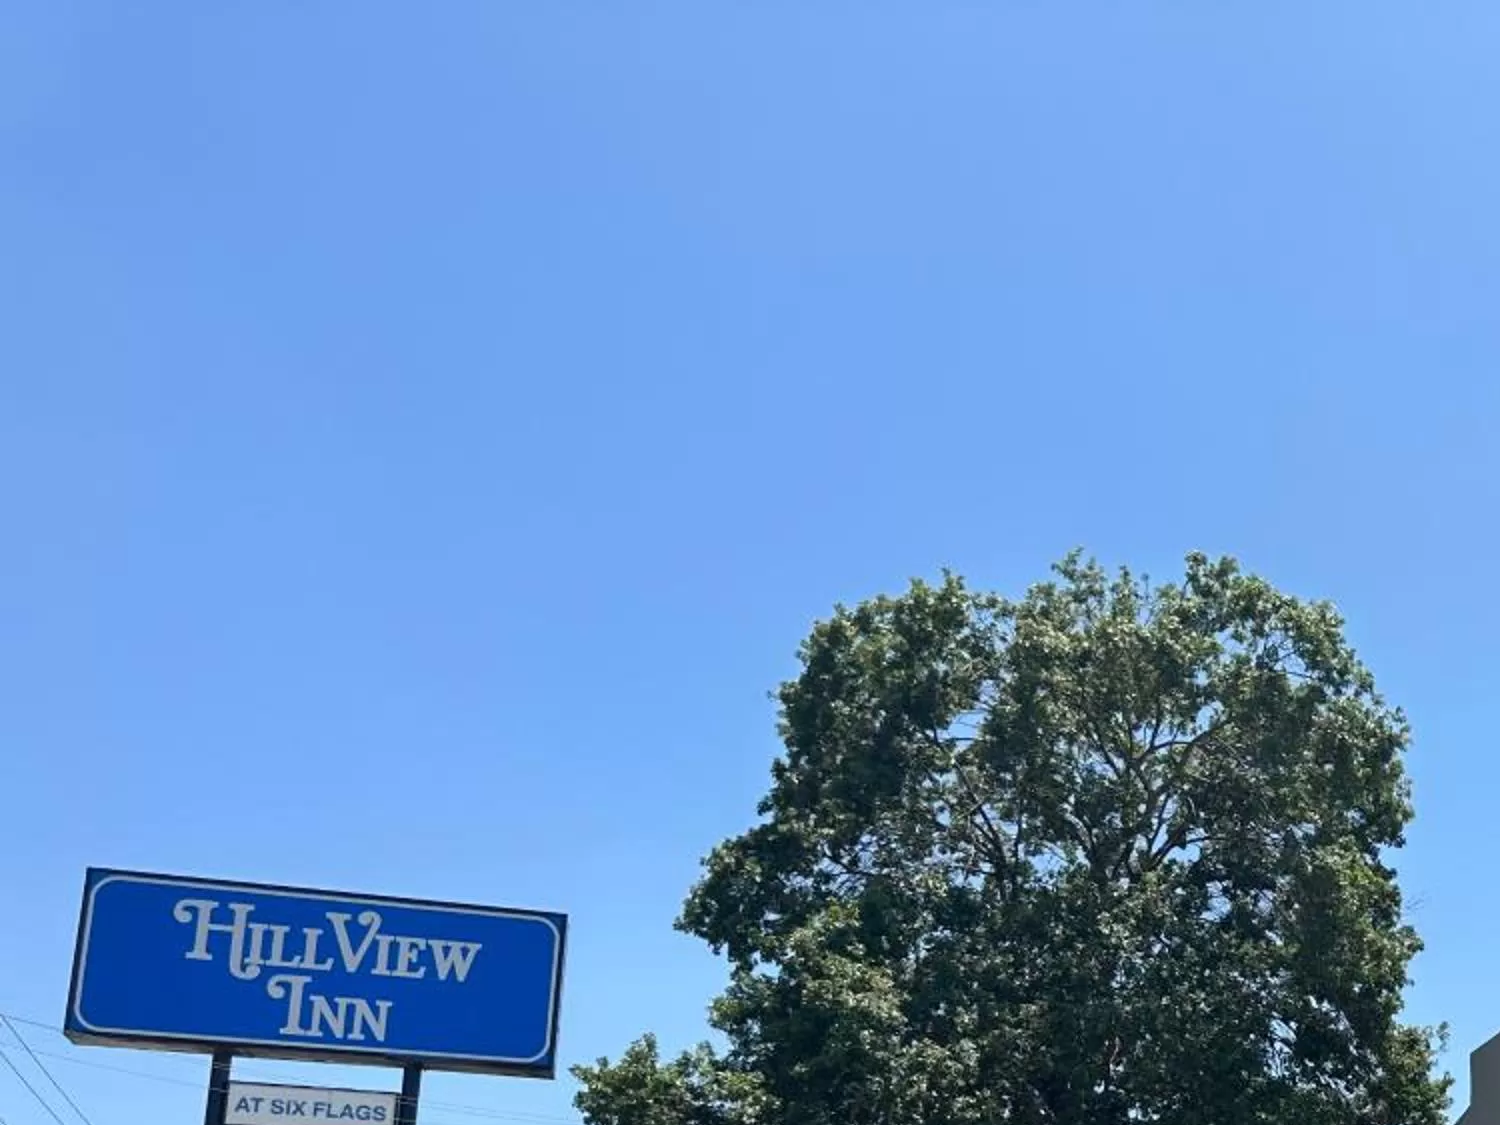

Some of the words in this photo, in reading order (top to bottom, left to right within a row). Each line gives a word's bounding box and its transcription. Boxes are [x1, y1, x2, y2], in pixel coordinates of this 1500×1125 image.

[267, 974, 393, 1042] INN
[234, 1096, 264, 1114] AT
[270, 1099, 308, 1117] SIX
[313, 1102, 387, 1122] FLAGS
